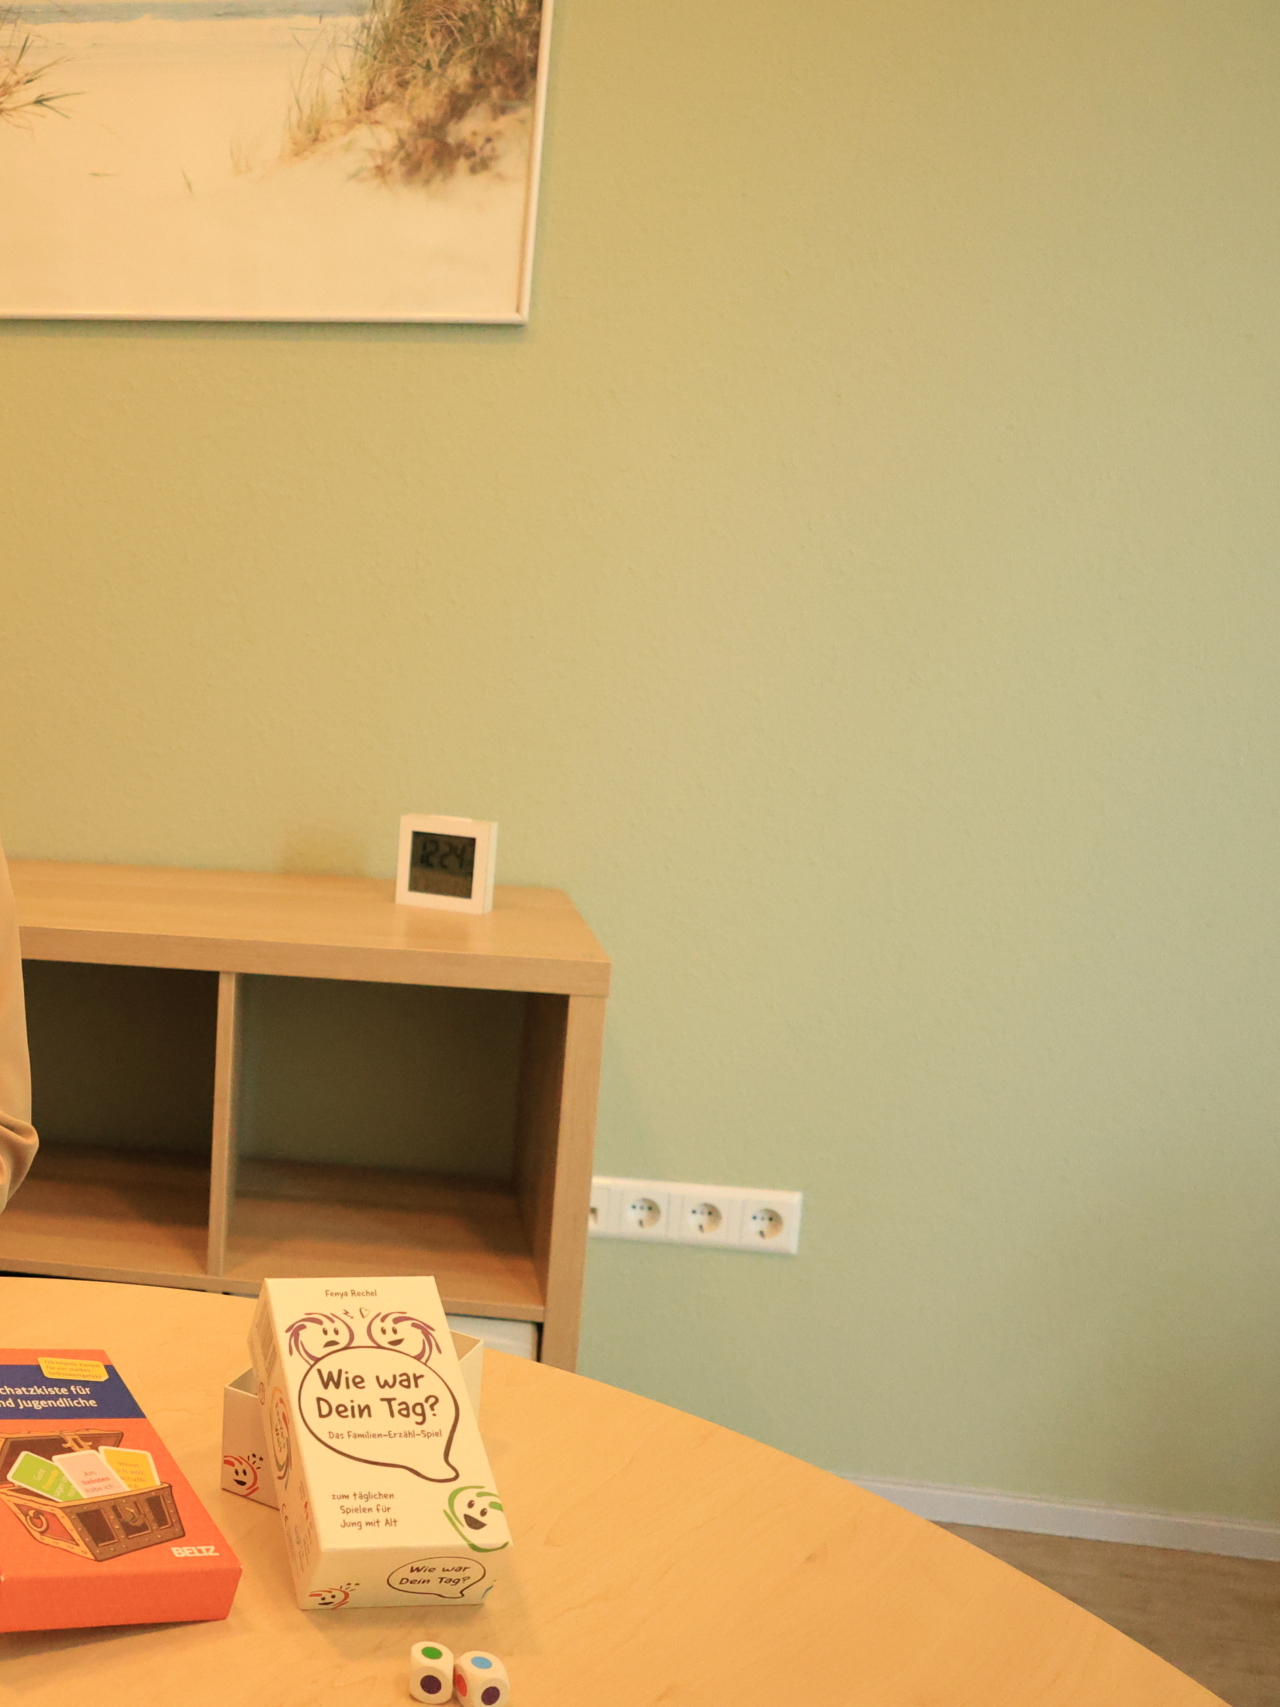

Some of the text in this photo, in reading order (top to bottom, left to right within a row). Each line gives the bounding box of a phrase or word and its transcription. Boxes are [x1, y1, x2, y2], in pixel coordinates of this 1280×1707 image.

[324, 1289, 377, 1299] Fenya Rechel
[316, 1368, 425, 1390] Wie war
[70, 1385, 91, 1395] für
[18, 1398, 98, 1410] Jugendliche
[315, 1394, 440, 1426] Dein Tag?
[328, 1429, 442, 1439] Das Familien-Erzähl-Spiel
[81, 1476, 111, 1485] liebsten
[352, 1491, 394, 1502] täglichen
[340, 1503, 392, 1515] Spielen für
[340, 1517, 398, 1530] Jung mit Alt
[170, 1545, 220, 1557] BELTZ
[409, 1565, 436, 1573] Wie
[399, 1576, 471, 1586] Dein Tag?
